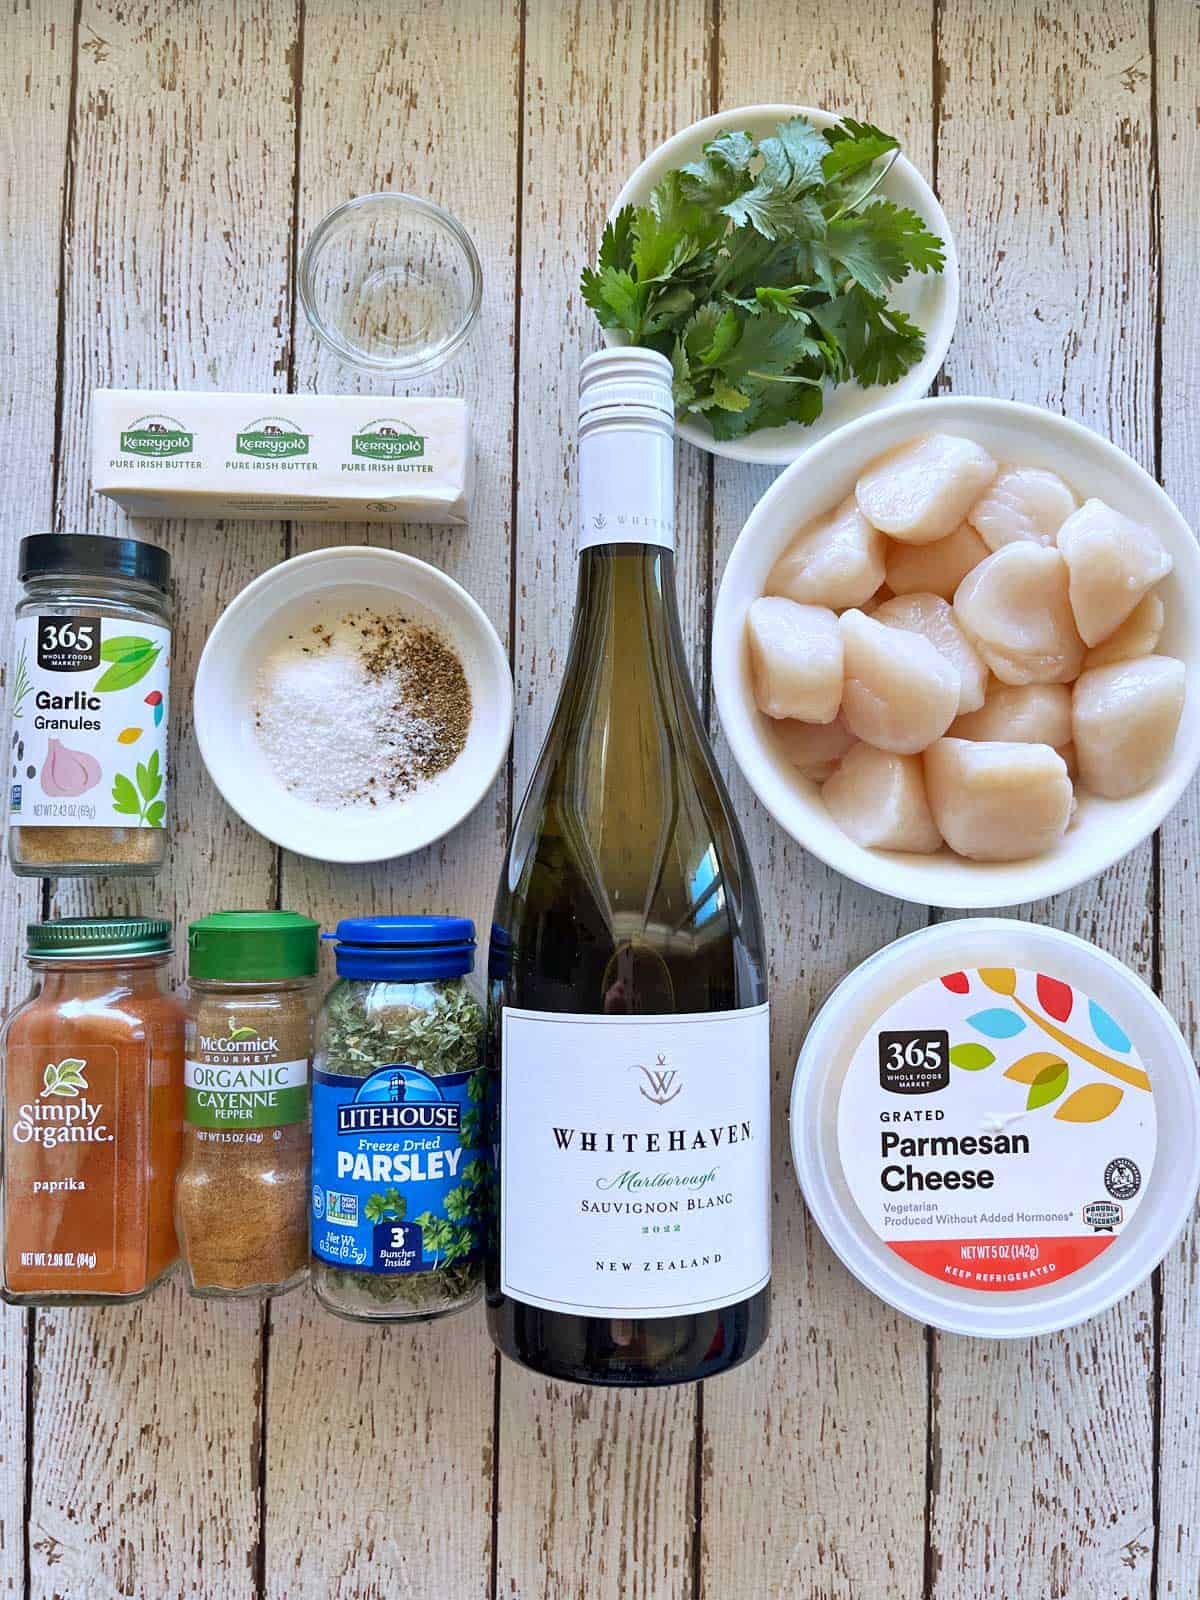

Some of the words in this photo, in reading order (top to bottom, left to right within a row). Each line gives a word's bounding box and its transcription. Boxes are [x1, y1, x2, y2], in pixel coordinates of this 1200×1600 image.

[110, 460, 134, 469] PURE
[137, 460, 163, 469] IRISH
[165, 460, 202, 469] BUTTER
[225, 461, 249, 470] PURE
[252, 462, 279, 470] IRISH
[280, 462, 318, 471] BUTTER
[341, 463, 366, 472] PURE
[368, 464, 394, 472] IRISH
[396, 464, 433, 473] BUTTER
[42, 622, 93, 651] 365
[35, 690, 102, 711] Garlic
[34, 716, 101, 731] Granules
[200, 1036, 281, 1052] McCormick
[204, 1054, 271, 1063] GOURMET
[886, 1038, 942, 1071] 365
[193, 1067, 289, 1088] ORGANIC
[197, 1091, 279, 1109] CAYENNE
[19, 1097, 103, 1129] Simply
[215, 1109, 254, 1120] PEPPER
[339, 1106, 459, 1130] LITEHOUSE
[880, 1109, 945, 1123] GRATED
[232, 1133, 244, 1143] OZ
[358, 1138, 400, 1152] Freeze
[403, 1135, 441, 1151] Dried
[552, 1119, 754, 1153] WHITEHAVEN
[881, 1131, 1030, 1158] Parmesan
[337, 1147, 463, 1182] PARSLEY
[33, 1177, 86, 1193] paprika
[596, 1165, 721, 1193] Marlborough
[880, 1164, 995, 1192] Cheese
[580, 1199, 679, 1215] SAUVIGNON
[687, 1192, 734, 1211] BLANC
[883, 1201, 938, 1214] Vegetarian
[1085, 1205, 1120, 1214] PROUDLY
[884, 1215, 933, 1226] Produced
[935, 1214, 977, 1225] Without
[980, 1212, 1014, 1223] Added
[640, 1223, 682, 1235] 2022
[340, 1233, 355, 1247] Wt
[21, 1252, 33, 1266] NET
[340, 1244, 367, 1265] (8.5g)
[379, 1249, 416, 1258] Bunches
[961, 1245, 977, 1259] NET
[977, 1245, 991, 1259] WT
[991, 1245, 998, 1259] 5
[998, 1245, 1010, 1259] OZ
[1010, 1244, 1039, 1261] (142g)
[384, 1258, 412, 1268] Inside
[596, 1261, 633, 1272] NEW
[643, 1253, 723, 1272] ZEALAND
[944, 1264, 972, 1279] KEEP
[975, 1263, 1056, 1282] REFRIGERATED
